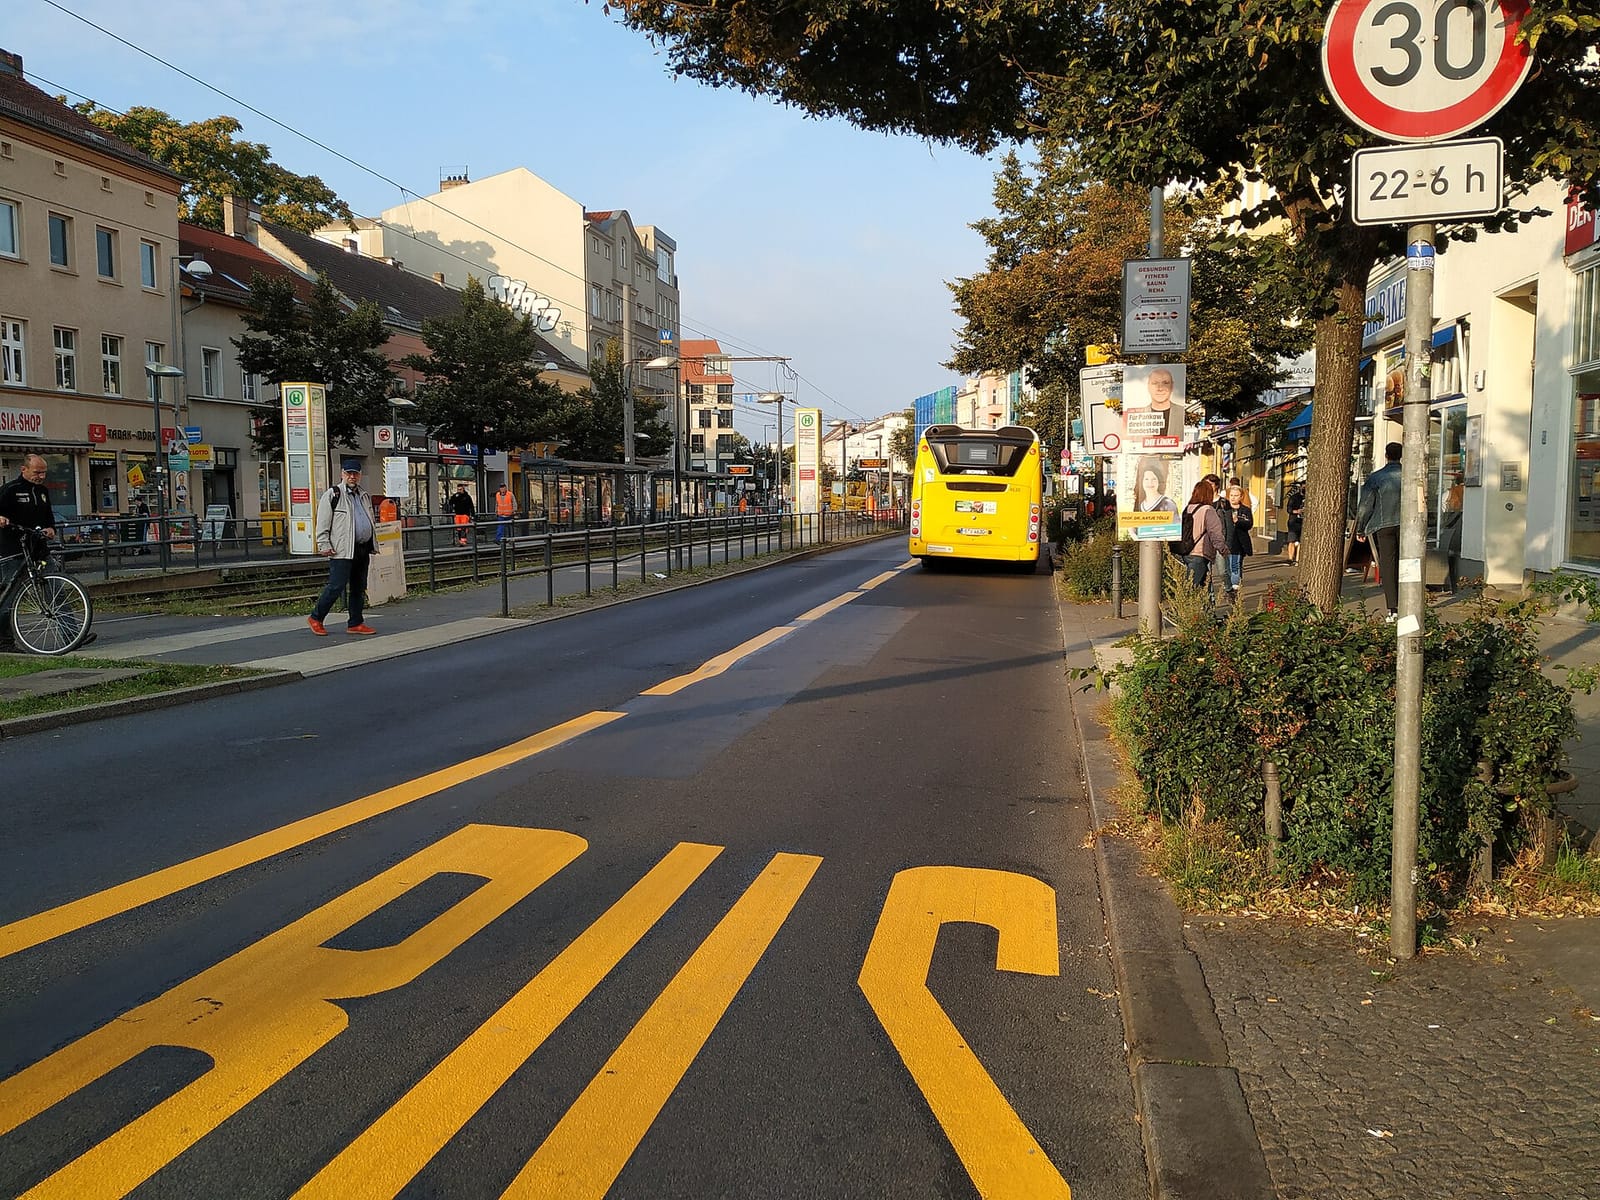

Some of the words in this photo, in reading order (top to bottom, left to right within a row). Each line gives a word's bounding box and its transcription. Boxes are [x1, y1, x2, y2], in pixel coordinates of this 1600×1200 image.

[1370, 0, 1486, 87] 30
[1369, 165, 1449, 201] 22-6
[1466, 164, 1484, 193] h
[1134, 311, 1178, 320] APOLLO
[1378, 276, 1408, 332] BAKE
[662, 331, 670, 340] W
[0, 412, 41, 433] SIA-SHOP
[1143, 438, 1156, 447] DIE
[0, 823, 1072, 1200] BUS
